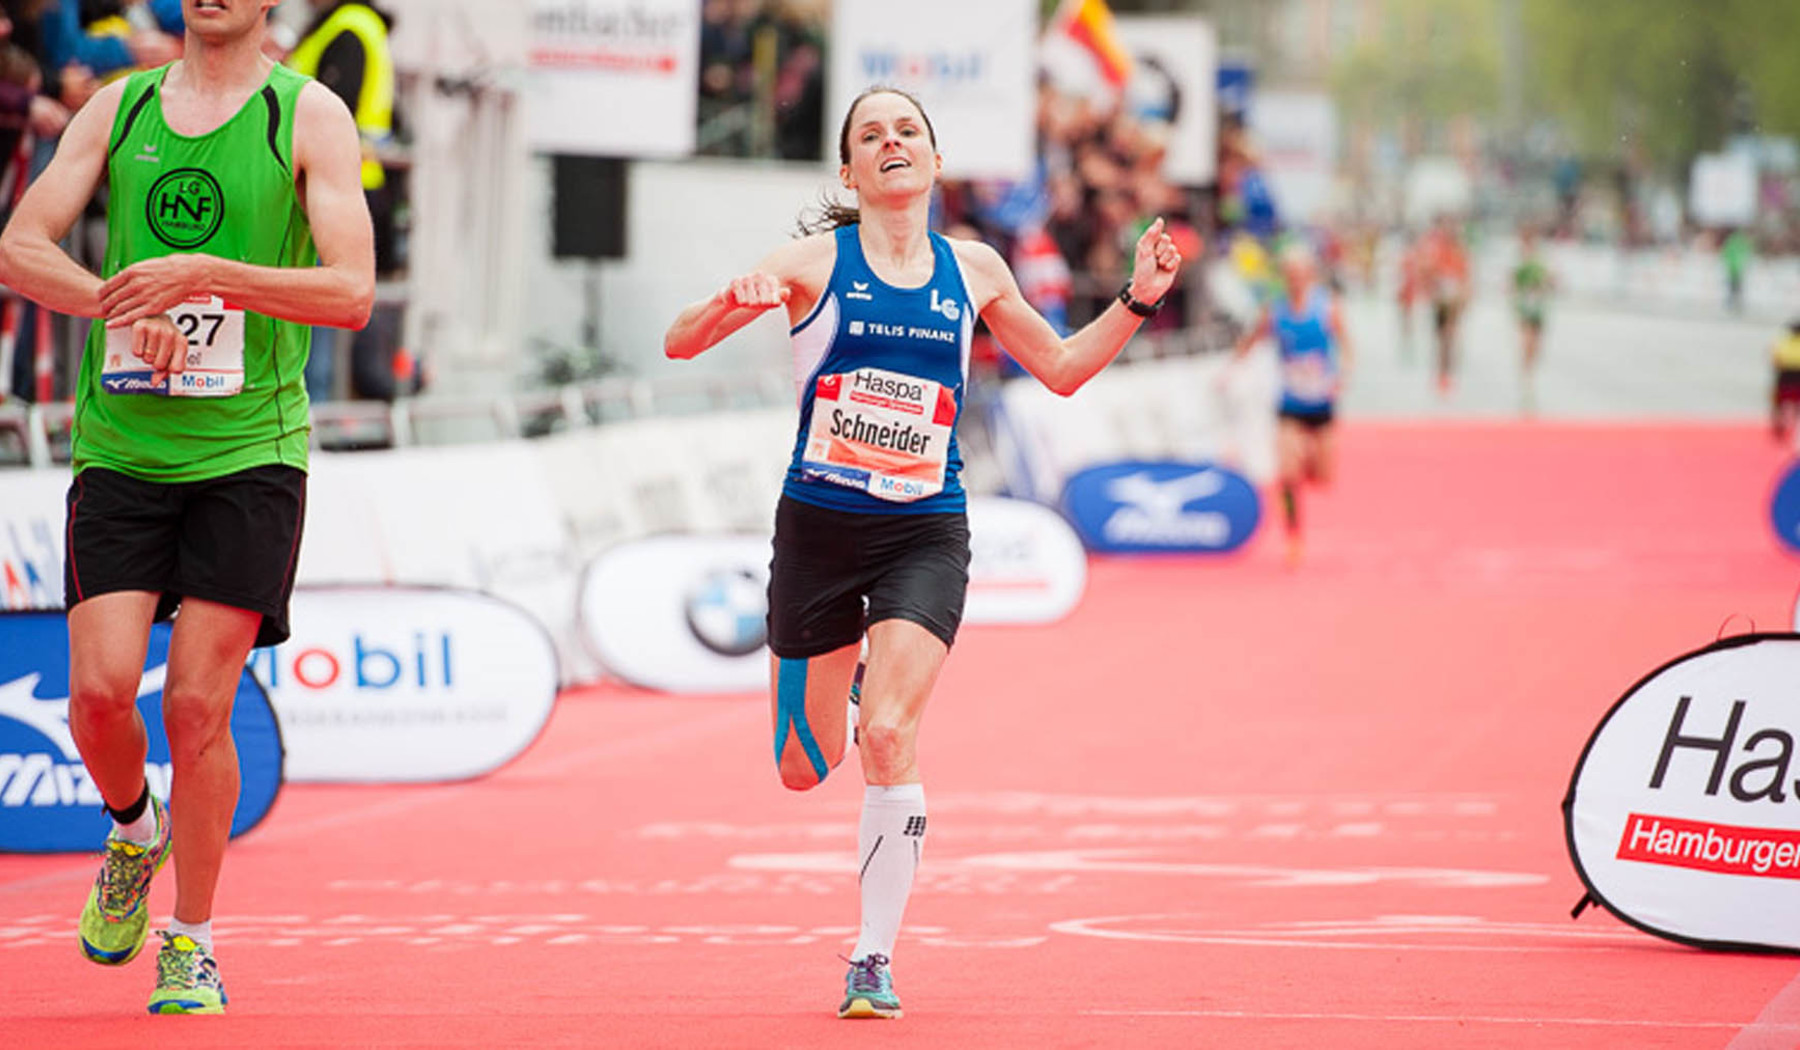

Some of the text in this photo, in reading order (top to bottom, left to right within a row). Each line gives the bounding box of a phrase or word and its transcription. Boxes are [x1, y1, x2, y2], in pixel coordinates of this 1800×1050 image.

[178, 180, 200, 195] LG
[868, 322, 905, 337] TELIS
[181, 375, 225, 388] Mobil
[854, 370, 923, 402] Haspa
[830, 408, 932, 456] Schneider
[880, 477, 924, 495] Mobil
[1649, 696, 1800, 804] Ha
